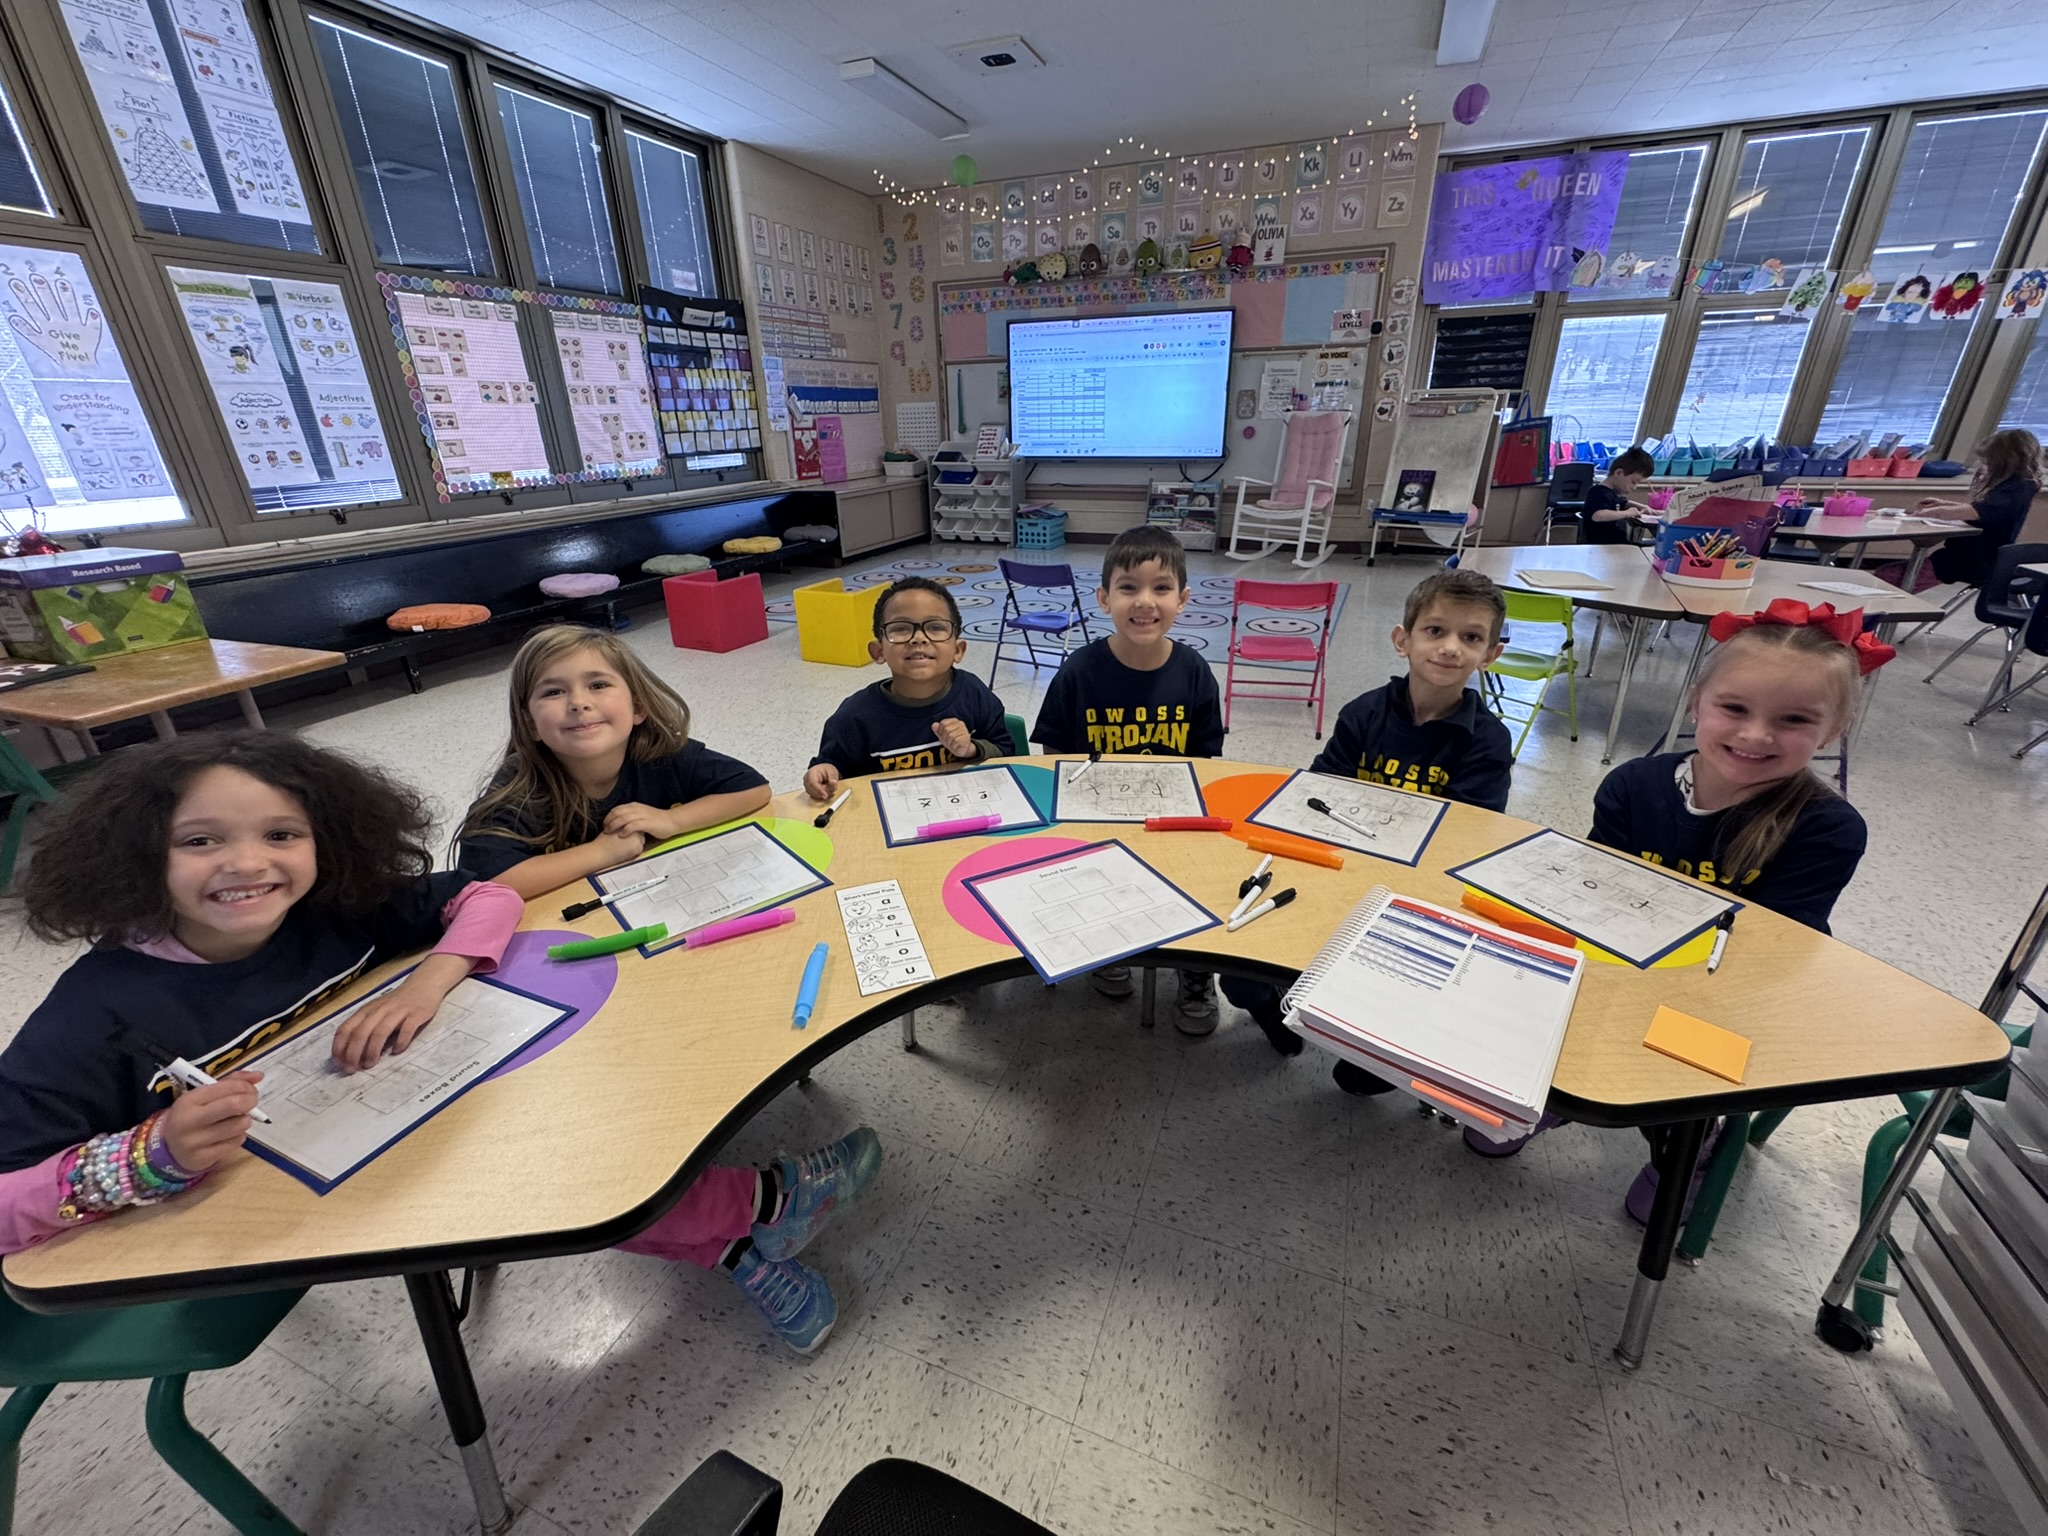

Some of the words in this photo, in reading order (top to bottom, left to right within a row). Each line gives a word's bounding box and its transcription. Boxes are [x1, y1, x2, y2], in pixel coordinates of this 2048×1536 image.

[131, 98, 151, 109] Plot
[228, 111, 260, 126] Fiction
[1074, 186, 1089, 200] Ee
[1108, 181, 1122, 195] Ff
[1144, 176, 1160, 193] Gg
[1262, 161, 1276, 178] Jj
[1304, 157, 1320, 173] Kk
[1390, 149, 1413, 162] Mm
[1452, 182, 1496, 209] THIS
[1532, 172, 1604, 202] QUEEN
[877, 203, 885, 236] 1
[945, 241, 959, 253] Nn
[977, 237, 991, 249] Oo
[1009, 235, 1022, 249] Pp
[1075, 228, 1089, 241] Rr
[1108, 225, 1121, 240] Ss
[1144, 221, 1158, 235] Tt
[1179, 214, 1195, 232] Uu
[1219, 214, 1234, 230] Vv
[1255, 212, 1277, 226] Ww
[1300, 206, 1316, 222] Xx
[1342, 203, 1357, 218] Yy
[1387, 197, 1405, 213] Zz
[903, 212, 919, 242] 2
[1257, 227, 1285, 241] OLIVIA
[882, 237, 897, 266] 3
[908, 244, 926, 273] 4
[25, 260, 37, 272] 3
[1432, 250, 1535, 283] MASTERED
[1543, 246, 1565, 269] IT
[54, 266, 66, 278] 4
[880, 272, 896, 300] 5
[909, 275, 925, 303] 6
[297, 292, 323, 303] Verbs
[889, 303, 903, 330] 7
[909, 315, 924, 343] 8
[1339, 320, 1363, 329] LEVELS
[48, 329, 80, 340] Give
[60, 340, 79, 351] Me
[58, 351, 90, 362] Five!
[890, 340, 906, 367] 9
[1320, 352, 1330, 360] NO
[1331, 351, 1349, 359] VOICE
[908, 366, 932, 394] 10
[60, 393, 91, 402] Check
[95, 393, 112, 402] for
[319, 394, 365, 404] Adjectives
[53, 402, 130, 415] Understanding
[1688, 490, 1707, 500] Must
[1721, 482, 1745, 492] Santa
[71, 565, 114, 577] Research
[114, 562, 142, 572] Based
[1086, 722, 1190, 755] TROJAN
[1039, 870, 1059, 878] Sound
[1060, 865, 1078, 873] Boxes
[732, 895, 754, 908] Sound
[843, 889, 881, 901] Short-Vowel
[709, 903, 731, 915] Boxes
[1524, 897, 1546, 911] Boxes
[1546, 907, 1572, 921] Sound
[895, 929, 900, 937] i
[905, 966, 916, 975] u
[449, 1060, 480, 1082] Sound
[418, 1082, 449, 1102] Boxes
